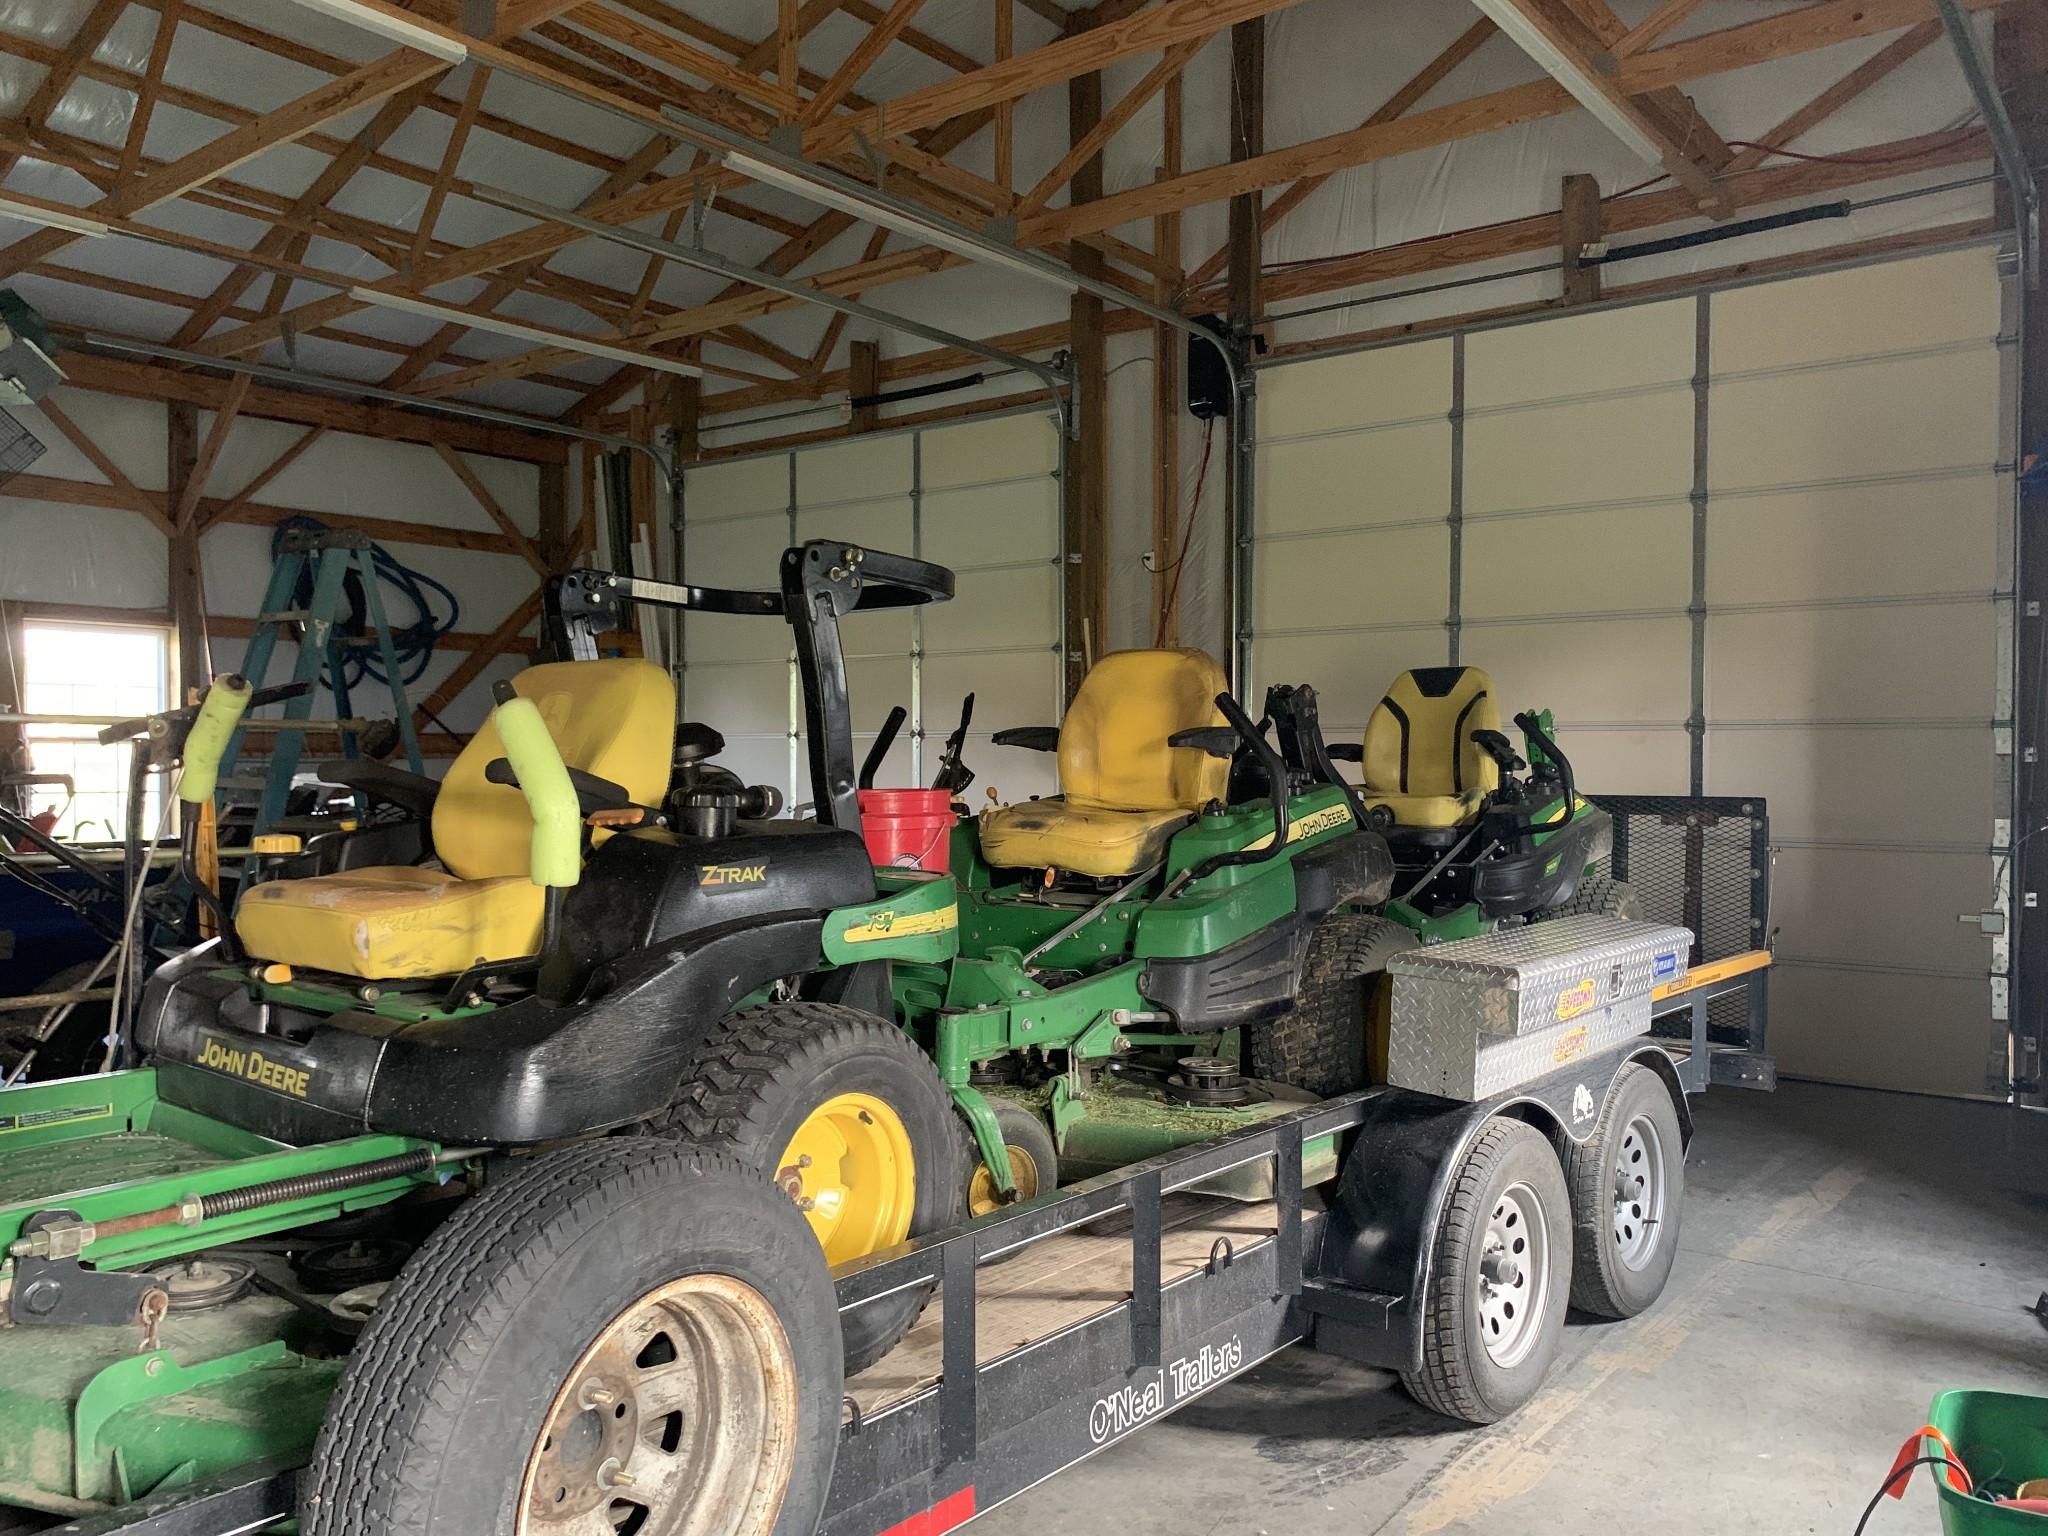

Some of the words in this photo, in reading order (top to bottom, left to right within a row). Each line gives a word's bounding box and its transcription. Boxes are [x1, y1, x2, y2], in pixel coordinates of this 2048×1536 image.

[1299, 820, 1322, 838] JOHN
[1321, 809, 1347, 828] DEERE
[197, 1037, 247, 1076] JOHN
[246, 1051, 310, 1097] DEERE
[1089, 1368, 1165, 1443] O'Neal
[1169, 1333, 1242, 1400] Trailers
